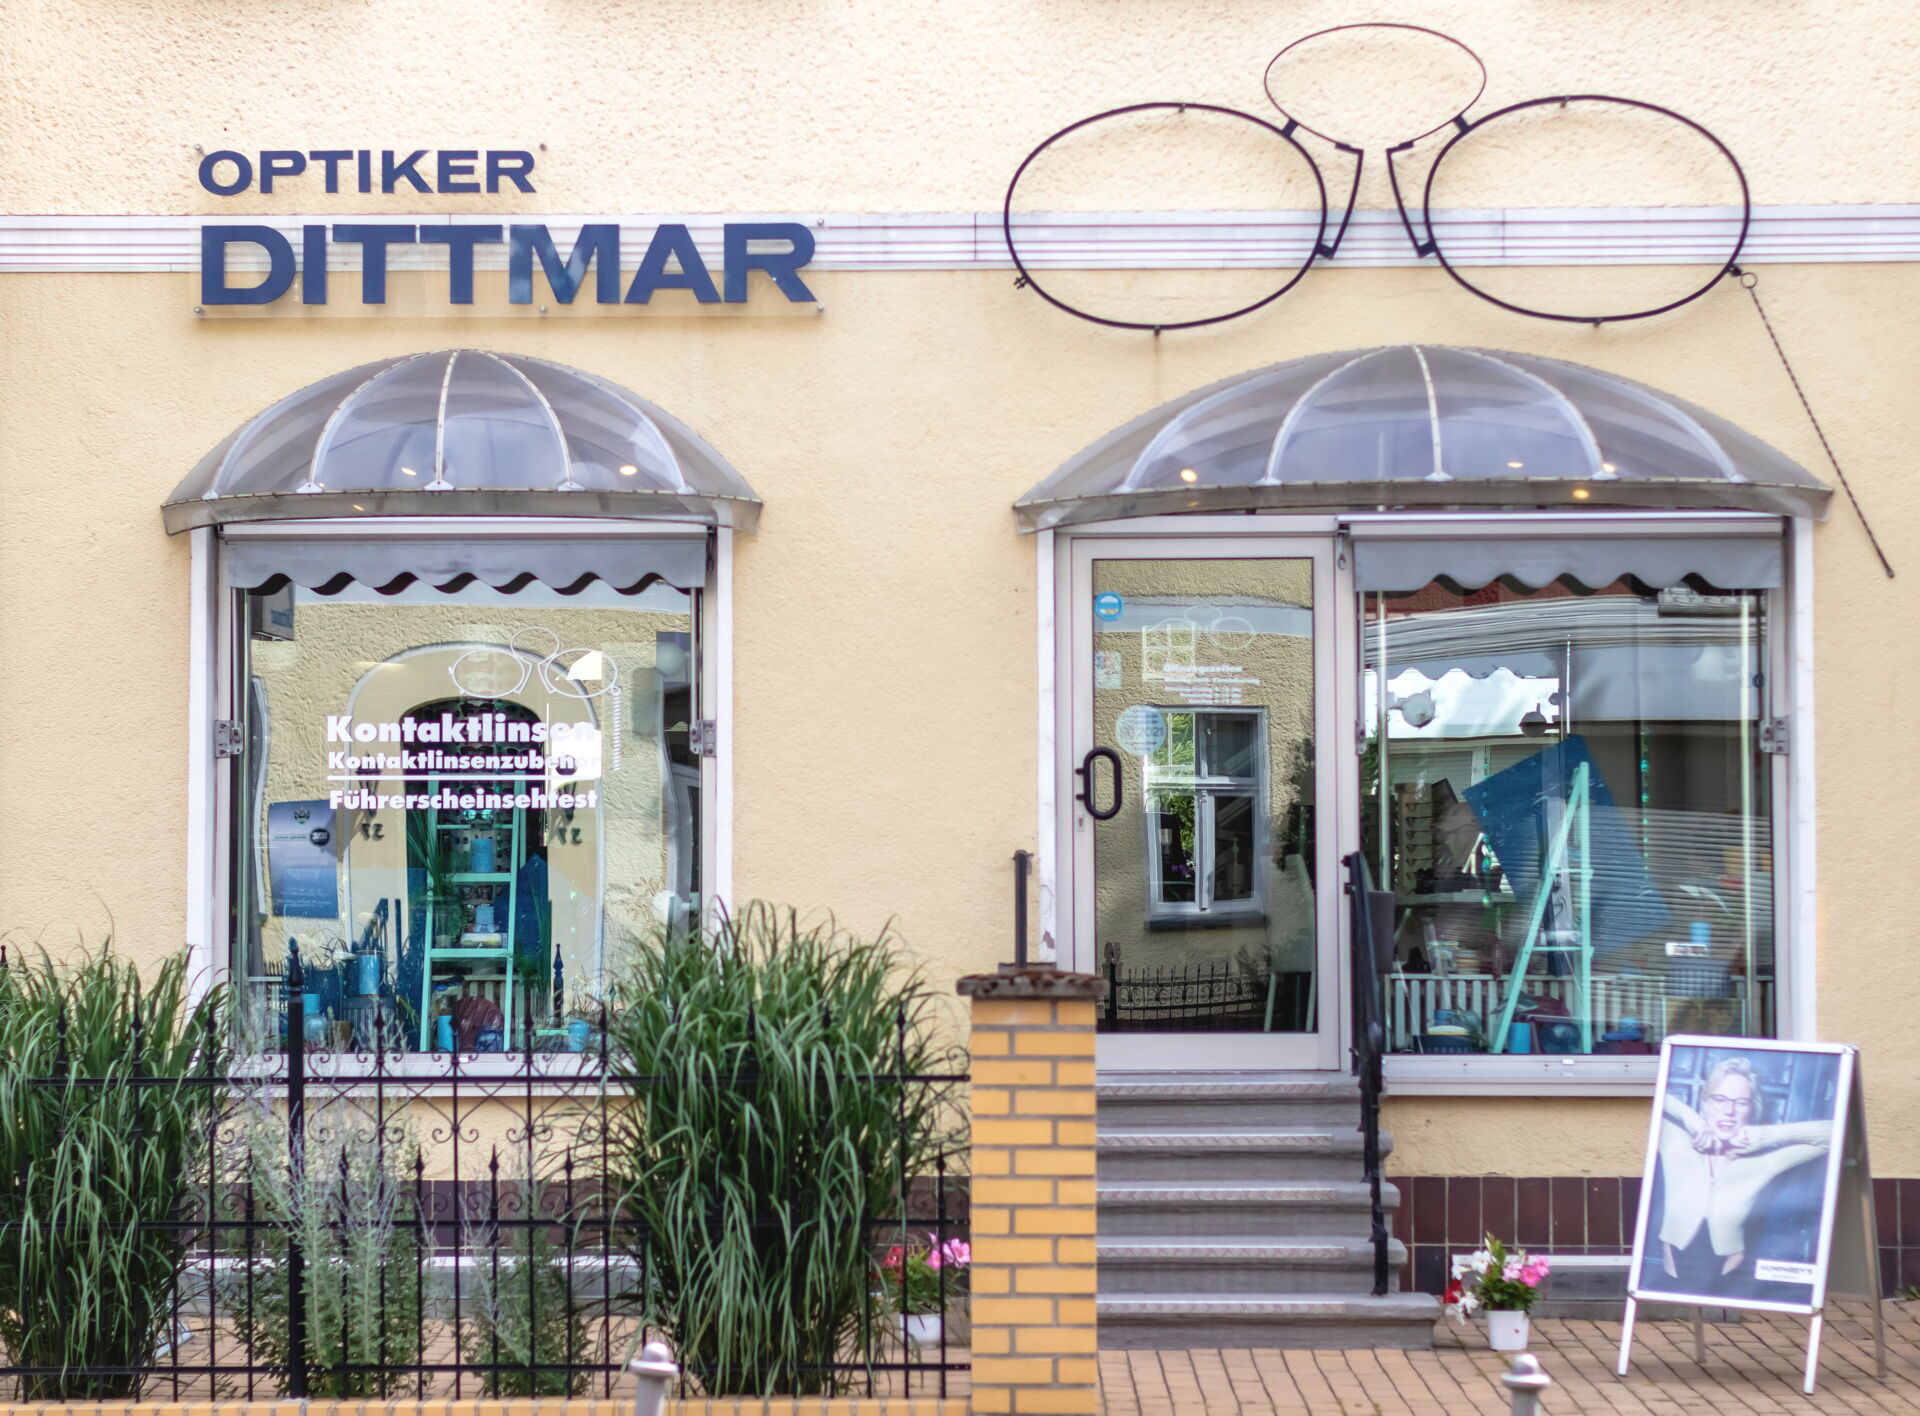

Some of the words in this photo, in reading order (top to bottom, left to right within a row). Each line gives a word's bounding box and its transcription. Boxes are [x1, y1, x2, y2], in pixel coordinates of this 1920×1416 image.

[198, 150, 536, 195] OPTIKER
[201, 223, 817, 305] DITTMAR
[327, 713, 595, 743] Kontaktlinsen
[329, 788, 597, 810] Führerscheinsehtest
